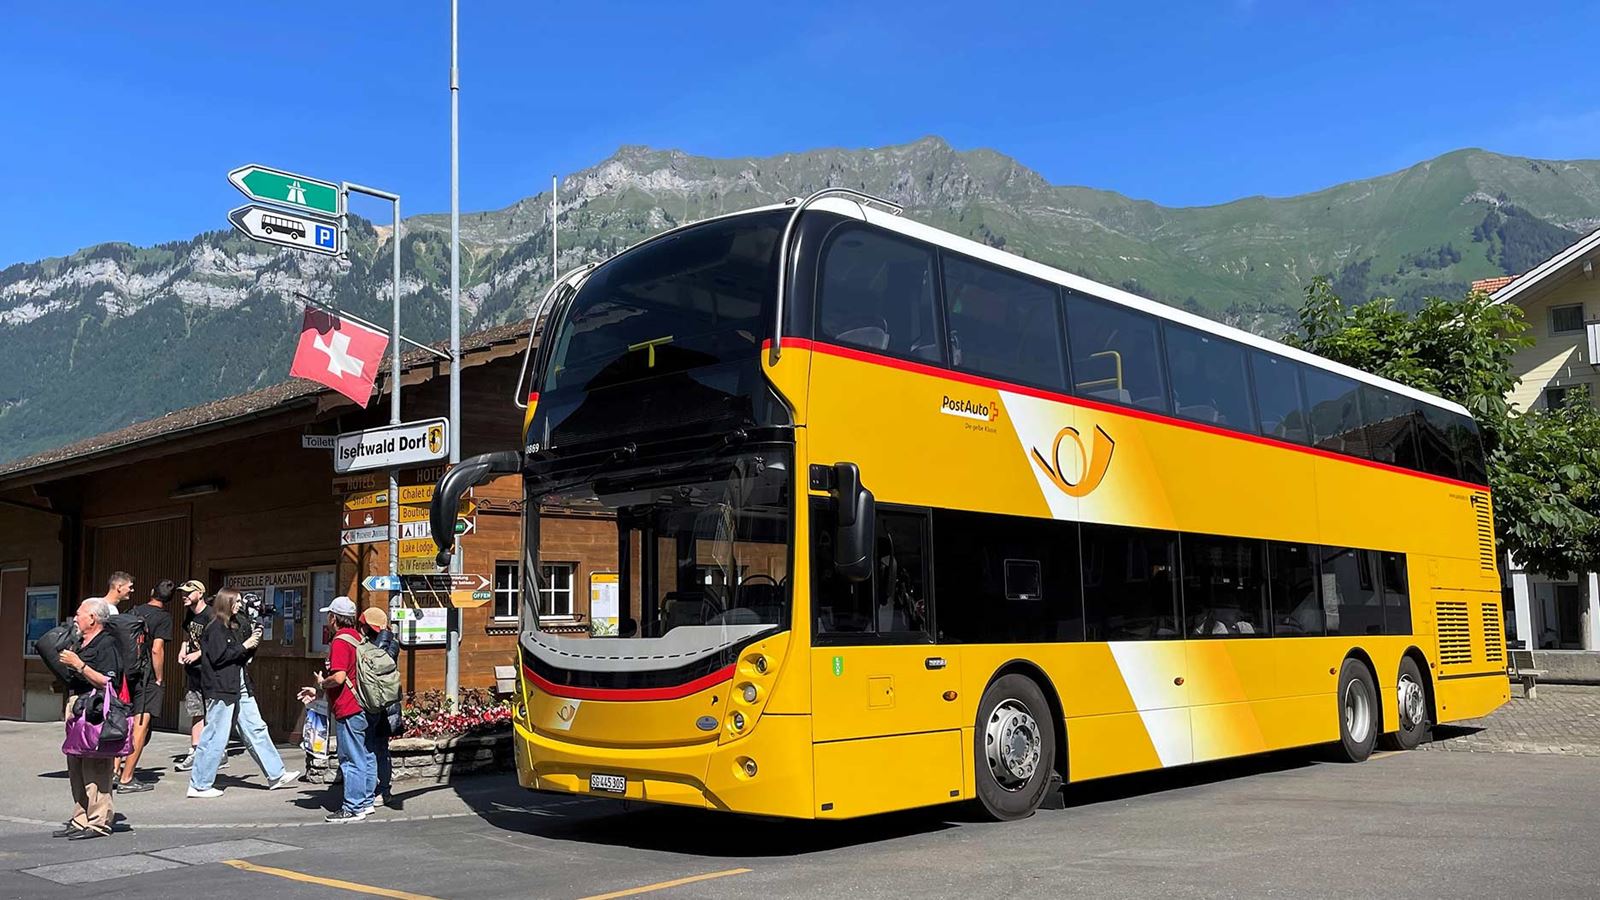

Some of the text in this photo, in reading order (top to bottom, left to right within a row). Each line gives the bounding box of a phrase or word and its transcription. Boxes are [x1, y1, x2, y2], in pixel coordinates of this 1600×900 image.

[320, 228, 330, 244] P
[942, 395, 989, 417] PostAuto
[305, 436, 335, 446] Toilett
[340, 433, 427, 460] Iseltwald Dorf
[416, 466, 446, 483] HOTEL
[347, 474, 376, 491] HOTELS
[352, 494, 373, 506] Strand
[402, 488, 425, 499] Chalet
[403, 508, 429, 518] Boutiqu
[402, 541, 434, 555] Lake Lodge
[229, 572, 307, 587] OFFIZIELLE PLAKATWAN
[592, 775, 600, 787] SG
